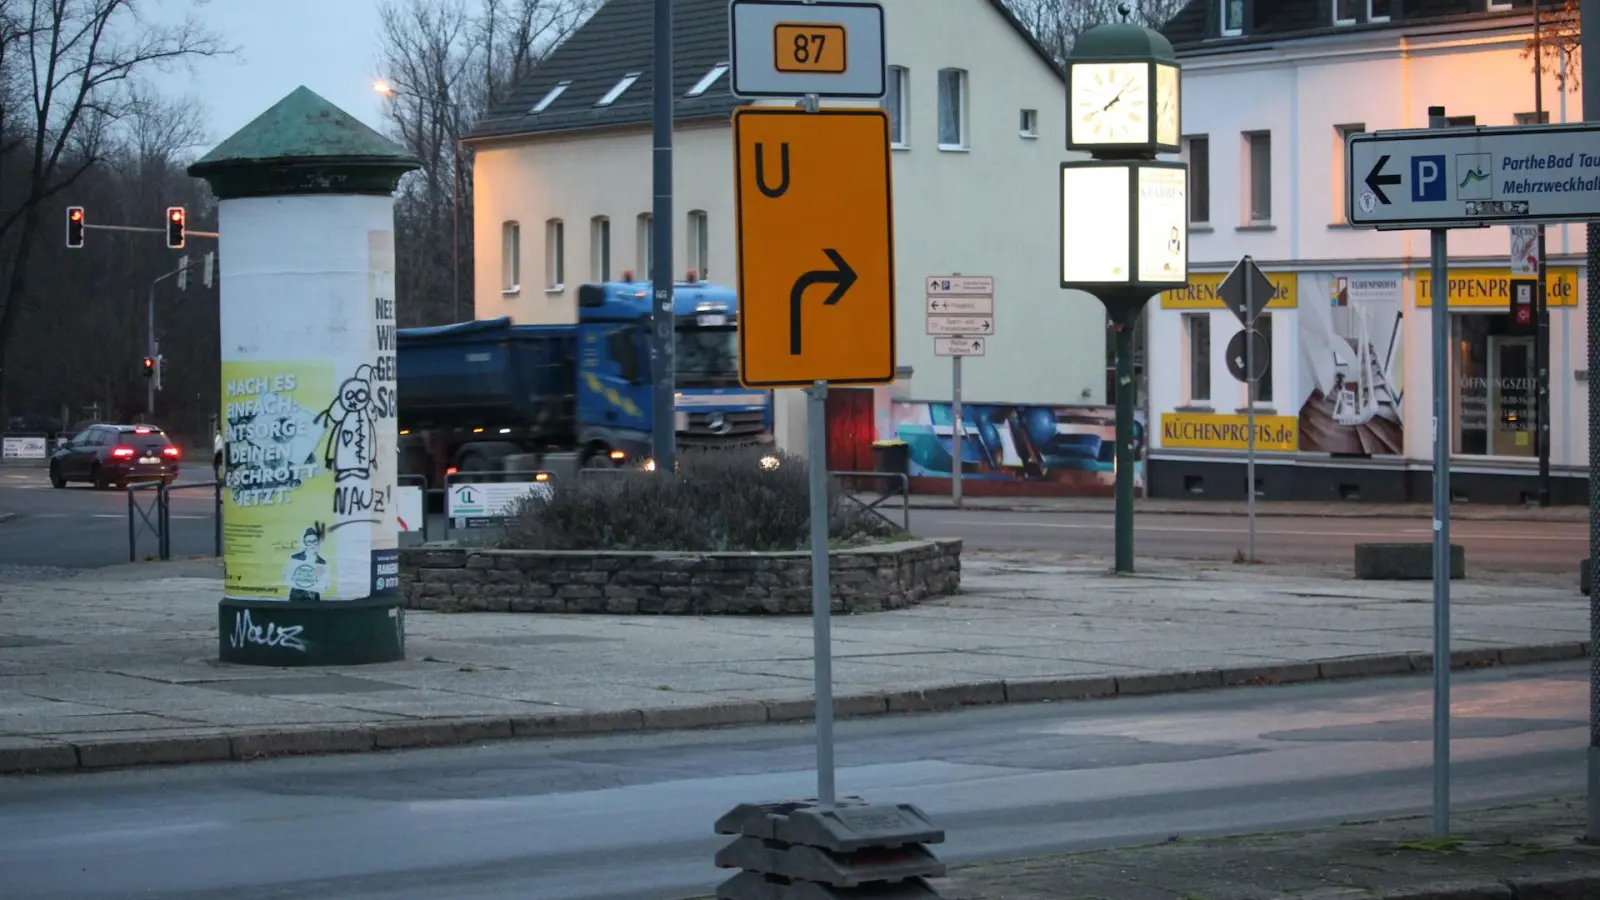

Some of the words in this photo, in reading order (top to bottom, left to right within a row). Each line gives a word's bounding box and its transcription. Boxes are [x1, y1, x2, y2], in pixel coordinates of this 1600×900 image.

[793, 33, 826, 64] 87
[754, 142, 790, 198] U
[1418, 160, 1438, 197] P
[274, 373, 296, 392] ES
[229, 445, 292, 465] DEINEN
